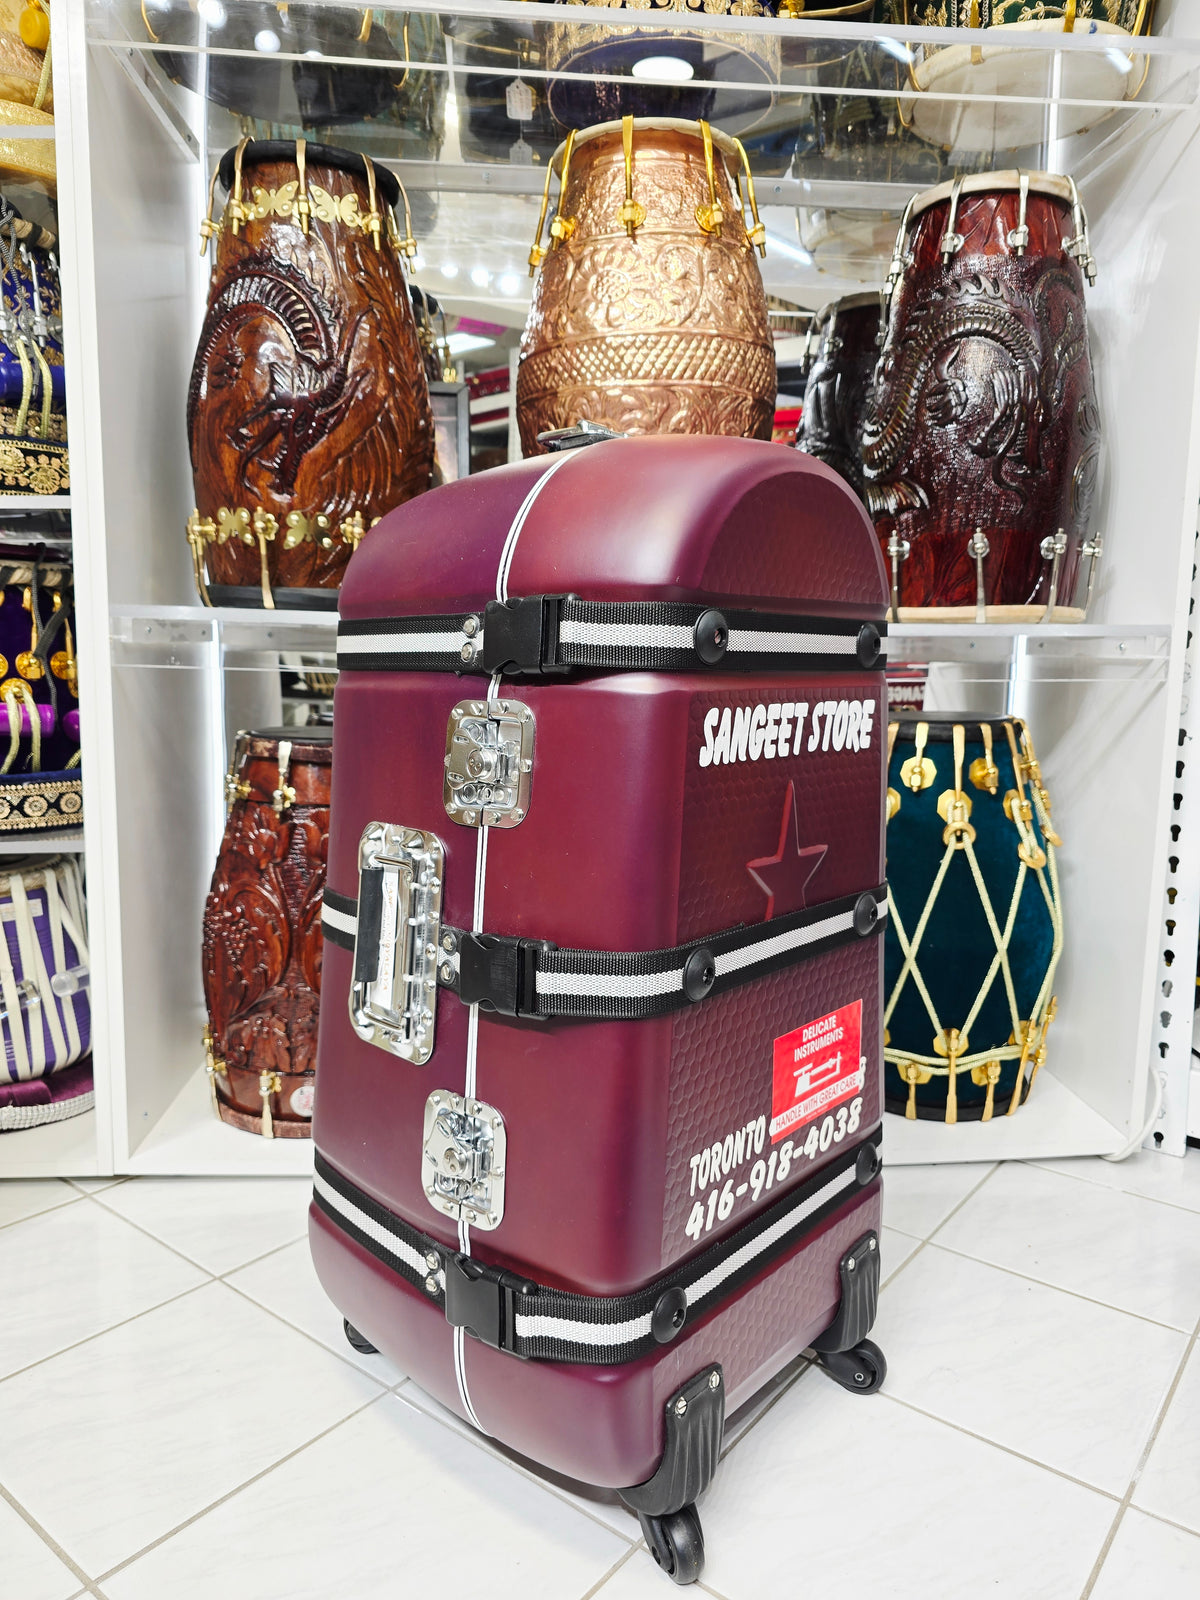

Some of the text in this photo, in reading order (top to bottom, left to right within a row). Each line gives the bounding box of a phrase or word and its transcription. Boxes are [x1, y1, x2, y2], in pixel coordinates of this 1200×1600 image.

[699, 699, 876, 767] SANGEET STORE
[794, 1026, 844, 1063] INSTRUMENTS
[802, 1014, 837, 1043] DELICATE
[775, 1105, 802, 1131] HANDLE
[803, 1095, 818, 1114] WITH
[818, 1083, 839, 1104] GREAT
[839, 1074, 857, 1093] CARE
[685, 1096, 863, 1241] 416-918-4038
[689, 1114, 767, 1197] TORONTO
